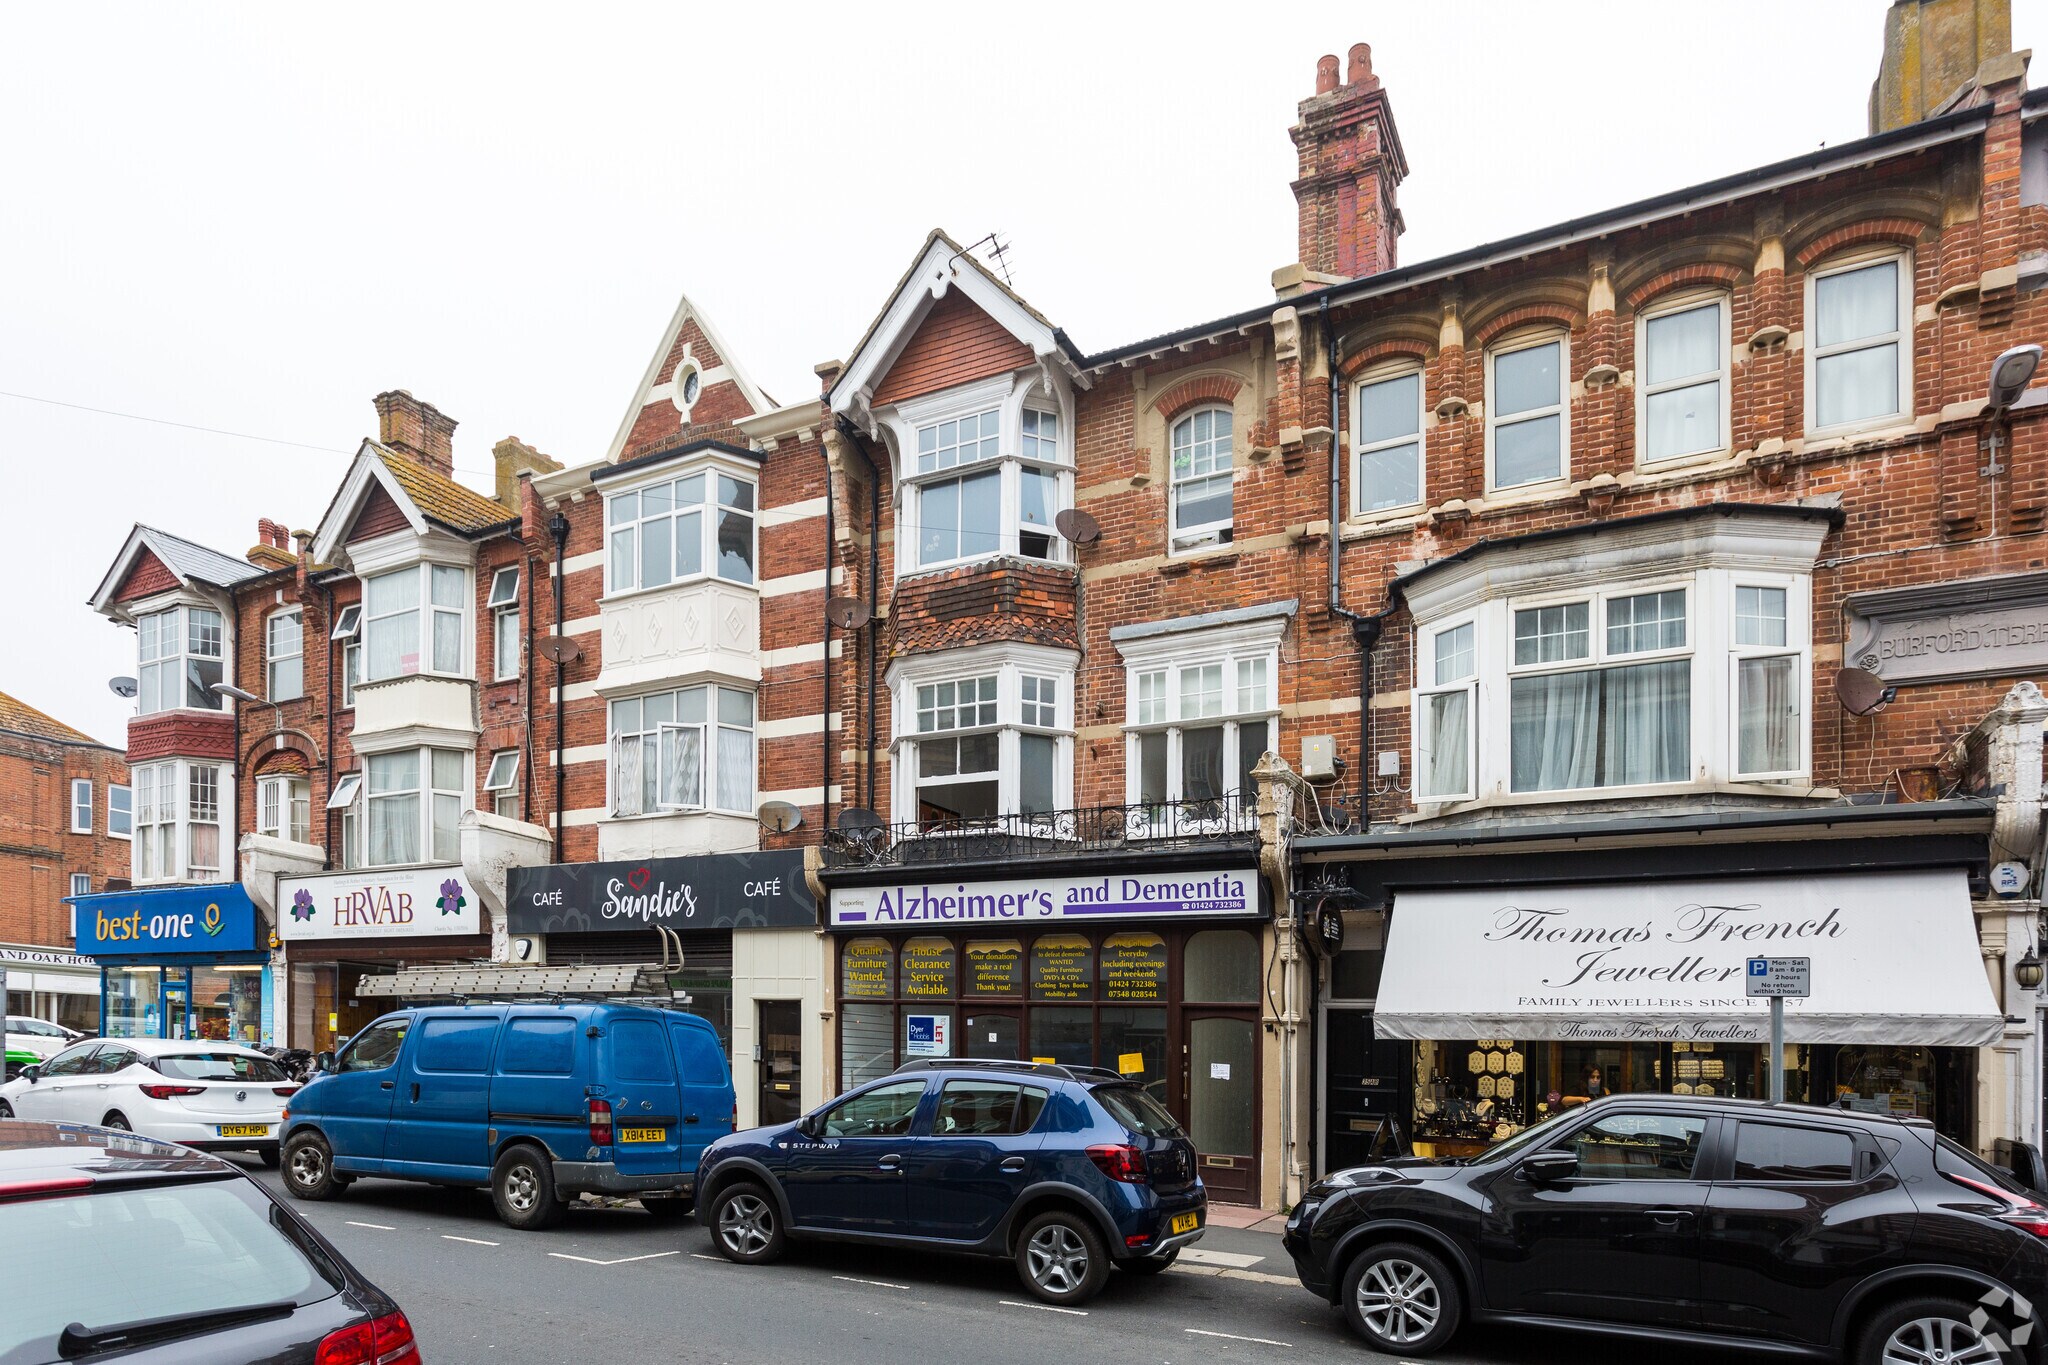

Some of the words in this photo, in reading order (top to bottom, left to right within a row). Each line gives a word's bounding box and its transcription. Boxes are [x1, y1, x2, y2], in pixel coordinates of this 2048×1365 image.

[743, 877, 781, 897] CAFÉ
[532, 888, 563, 907] CAFÉ
[601, 877, 698, 922] Sandie's
[874, 885, 1053, 921] Alzheimer's
[1066, 878, 1109, 903] and
[1122, 873, 1245, 901] Dementia
[333, 886, 414, 926] HRVAB
[839, 899, 864, 908] Supporting
[1215, 901, 1242, 909] 732386
[96, 909, 194, 941] best-one
[1483, 905, 1653, 944] Thomas
[1665, 903, 1849, 944] French
[851, 945, 884, 957] Quality
[912, 947, 942, 956] House
[985, 952, 1018, 960] donations
[1118, 950, 1149, 958] Everyday
[32, 952, 63, 963] OAK
[847, 958, 888, 969] Furniture
[904, 959, 951, 969] Clearance
[1102, 960, 1134, 968] Including
[1135, 960, 1165, 968] evenings
[1753, 962, 1765, 974] P
[849, 971, 885, 981] Wanted.
[911, 971, 944, 981] Service
[977, 973, 1010, 981] difference
[907, 984, 949, 995] Available
[996, 983, 1011, 992] you!
[1517, 996, 1583, 1006] FAMILY
[1586, 997, 1693, 1007] JEWELLERS
[1699, 998, 1758, 1007] SINCE
[1763, 998, 1805, 1007] 157
[910, 1024, 924, 1034] Dyer
[935, 1025, 943, 1044] LET
[1558, 1019, 1618, 1038] Thomas
[1620, 1019, 1680, 1038] French
[1681, 1019, 1758, 1040] Jewellers
[222, 1126, 247, 1135] DY67
[249, 1125, 267, 1134] HPU
[646, 1129, 663, 1140] EET
